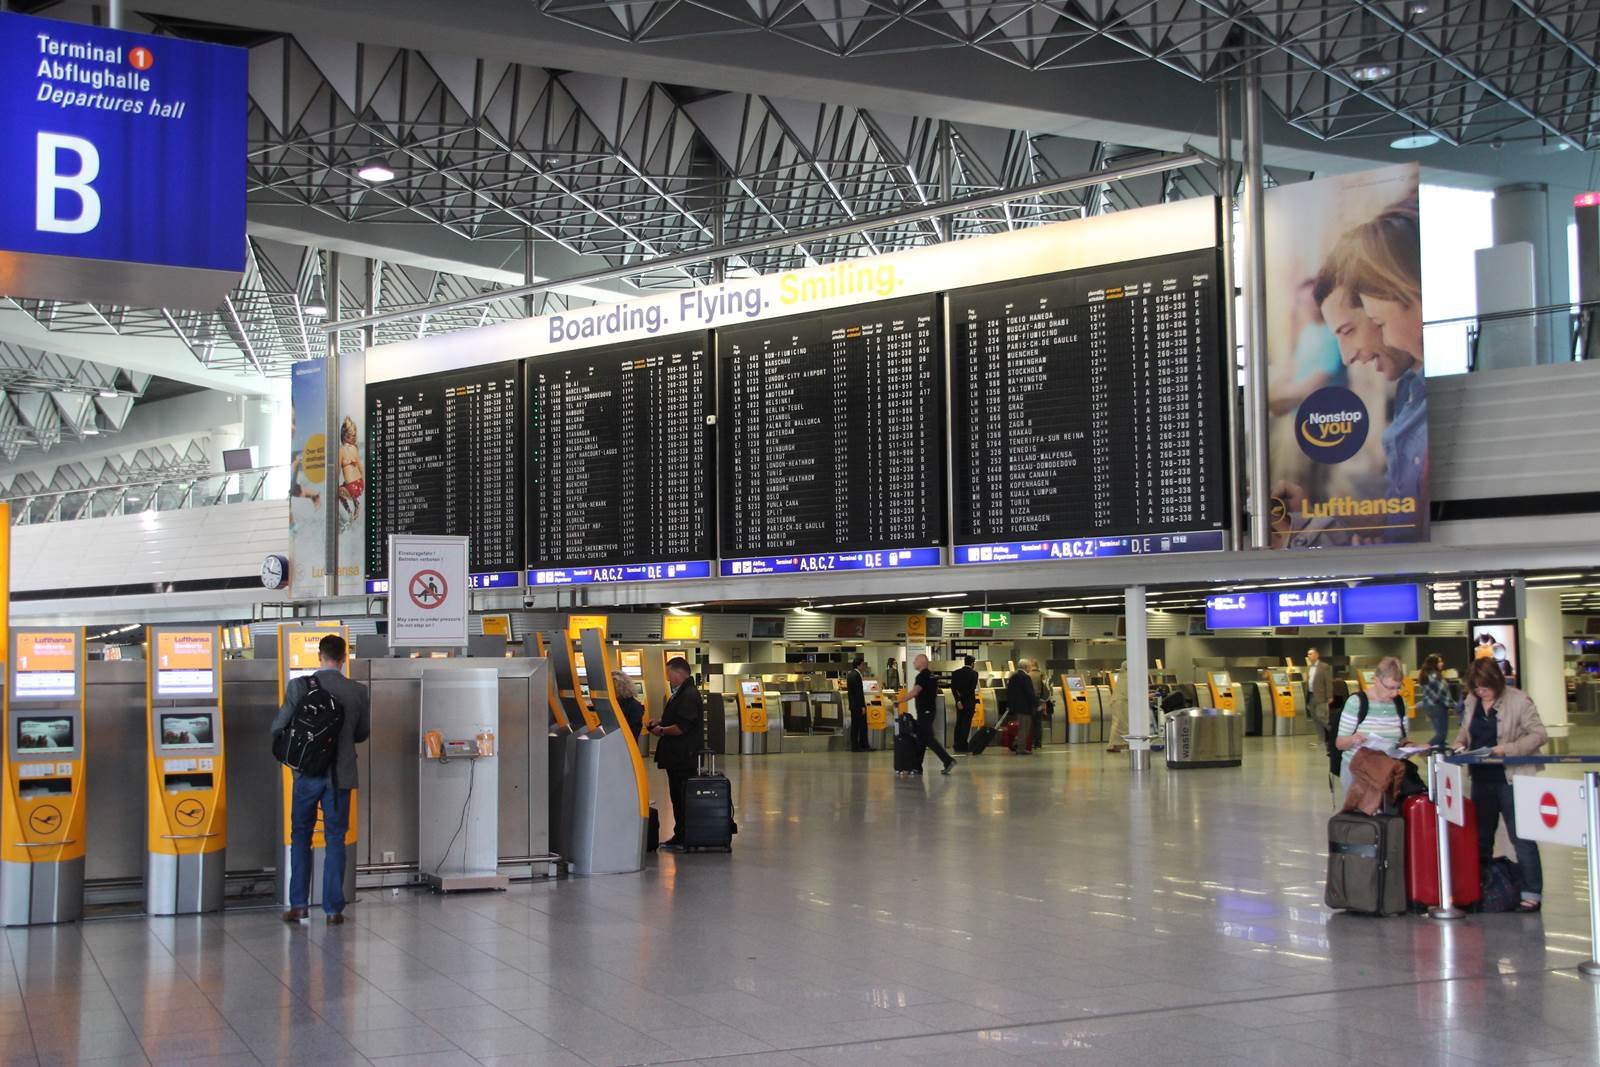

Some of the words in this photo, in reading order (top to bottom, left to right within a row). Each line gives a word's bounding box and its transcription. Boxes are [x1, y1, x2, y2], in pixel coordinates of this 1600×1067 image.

[38, 34, 122, 64] Terminal
[136, 50, 144, 67] 1
[38, 60, 150, 91] Abflughalle
[38, 84, 142, 114] Departures
[150, 99, 185, 119] hall
[36, 132, 101, 234] B
[549, 303, 668, 344] Boarding.
[680, 286, 770, 324] Flying.
[780, 263, 904, 305] Smiling.
[1007, 315, 1026, 324] TOKIO
[1030, 311, 1054, 321] HANEDA
[1054, 334, 1078, 344] GAULLE
[1008, 348, 1038, 359] MUENCHEN
[1008, 356, 1046, 367] BIRMINGHAM
[1008, 365, 1043, 376] STOCKHOLM
[765, 381, 788, 390] CATANIA
[1008, 393, 1024, 402] PRAG
[766, 403, 804, 413] BERLIN-TEGEL
[1008, 402, 1024, 410] GRAZ
[1009, 411, 1024, 419] OSLO
[1310, 411, 1362, 424] Nonstop
[1009, 427, 1032, 436] KRAKAU
[1320, 420, 1352, 439] you
[1064, 431, 1084, 440] REINA
[1009, 444, 1036, 454] VENEDIG
[1029, 469, 1057, 478] CANARIA
[1010, 479, 1049, 488] KOPENHAGEN
[1010, 489, 1030, 497] KUALA
[1033, 487, 1057, 495] LUMPUR
[1010, 498, 1030, 506] TURIN
[1302, 496, 1416, 518] Lufthansa
[1010, 506, 1030, 514] NIZZA
[1010, 514, 1050, 523] KOPENHAGEN
[1011, 523, 1038, 532] FLORENZ
